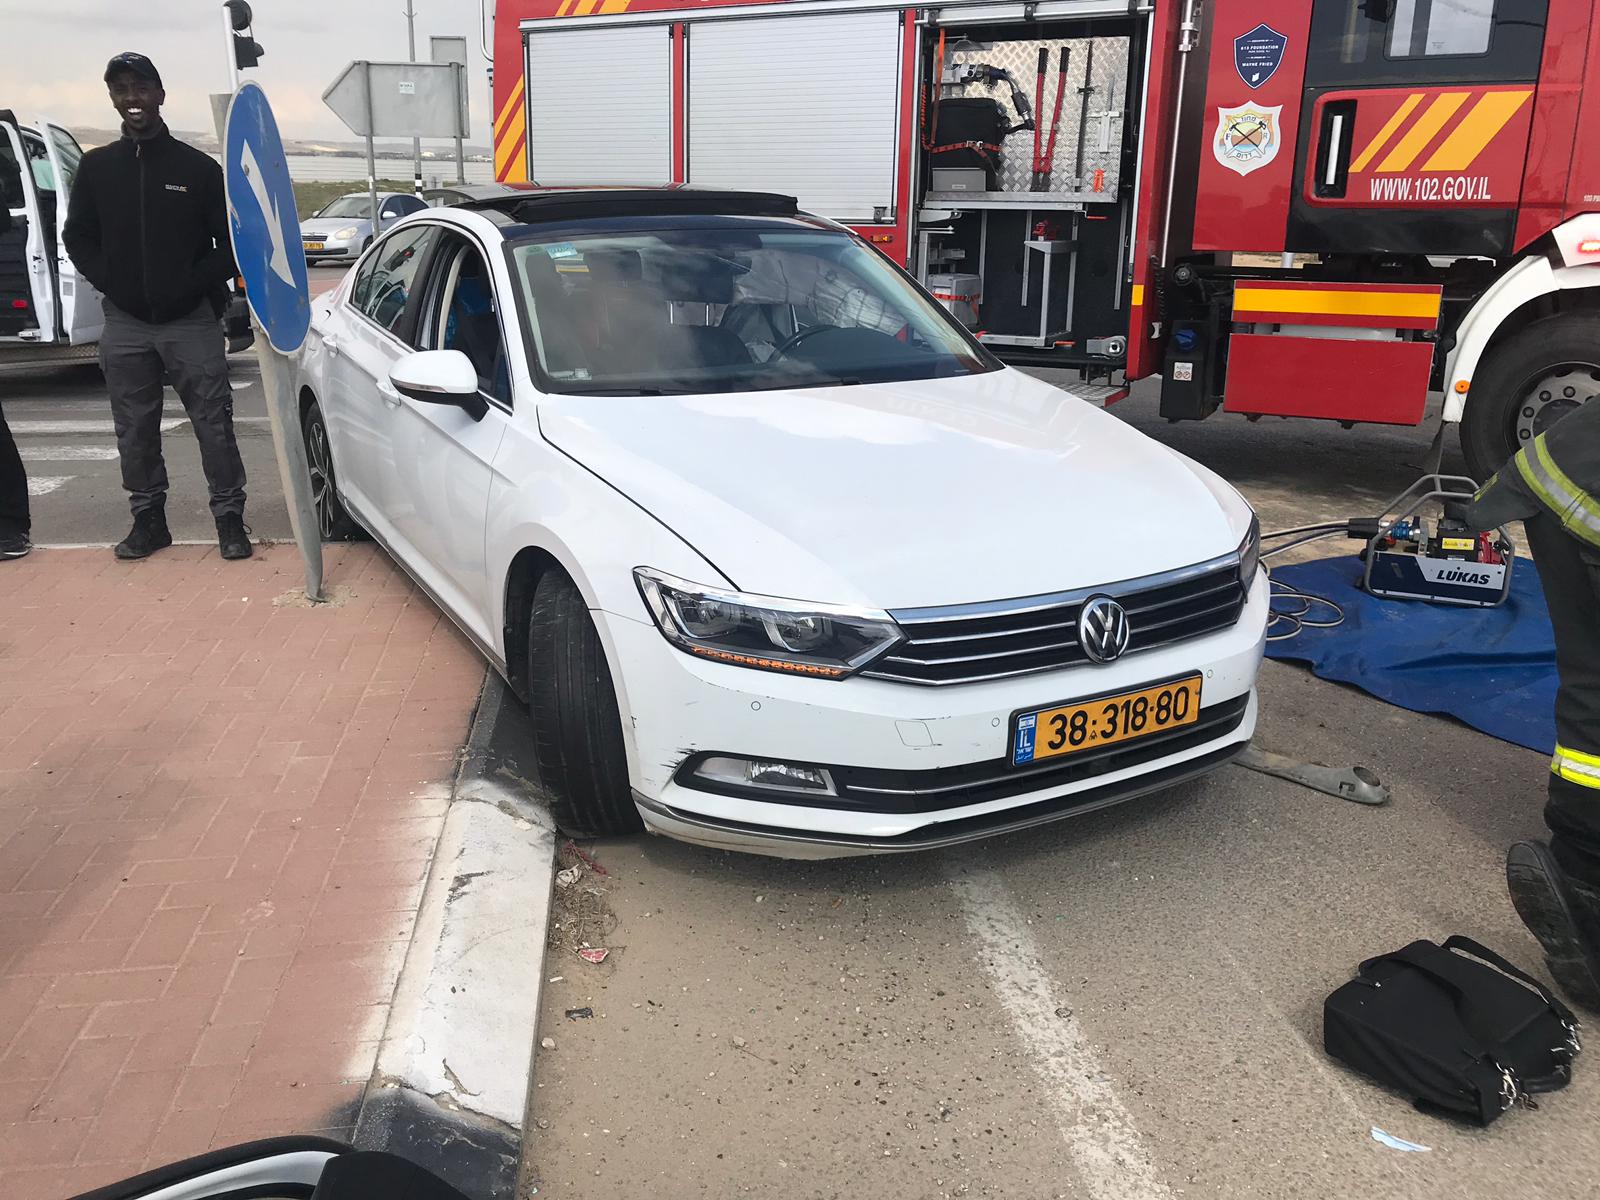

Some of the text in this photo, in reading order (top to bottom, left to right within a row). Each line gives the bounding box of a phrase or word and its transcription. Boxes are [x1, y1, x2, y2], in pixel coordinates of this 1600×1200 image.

[1370, 176, 1491, 200] WWW.102.GOV.IL
[1436, 569, 1490, 585] LUKAS
[1019, 730, 1031, 748] IL
